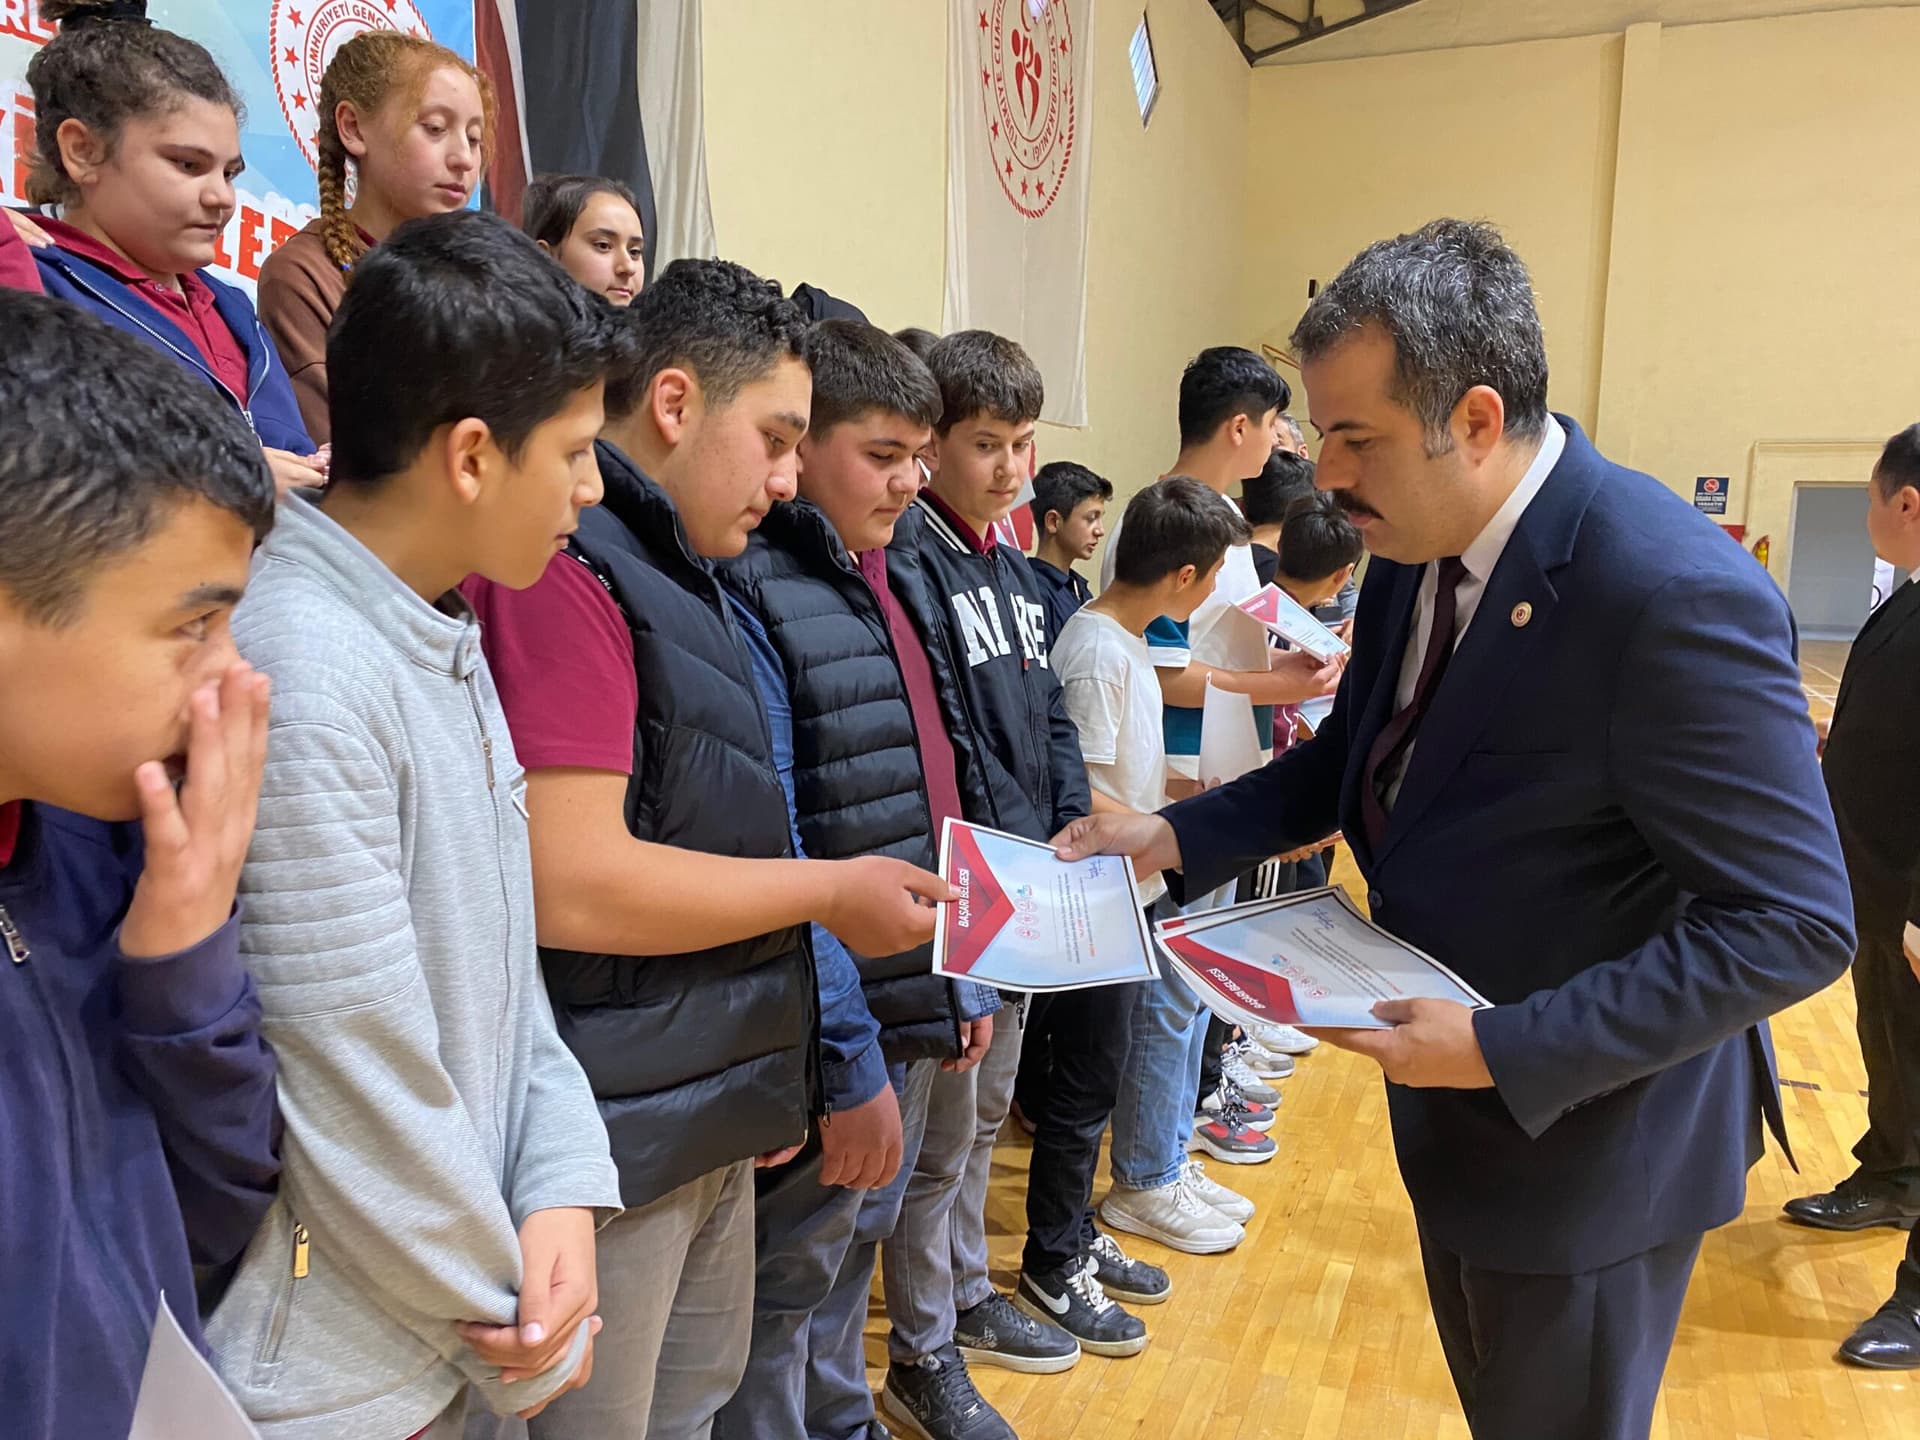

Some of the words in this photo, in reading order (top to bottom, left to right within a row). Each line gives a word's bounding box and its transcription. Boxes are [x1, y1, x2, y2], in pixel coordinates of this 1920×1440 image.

[310, 2, 350, 85] CUMHURİYETİ
[951, 586, 1048, 669] NIKE
[957, 867, 970, 899] BELGESİ
[957, 897, 972, 928] BAŞARI
